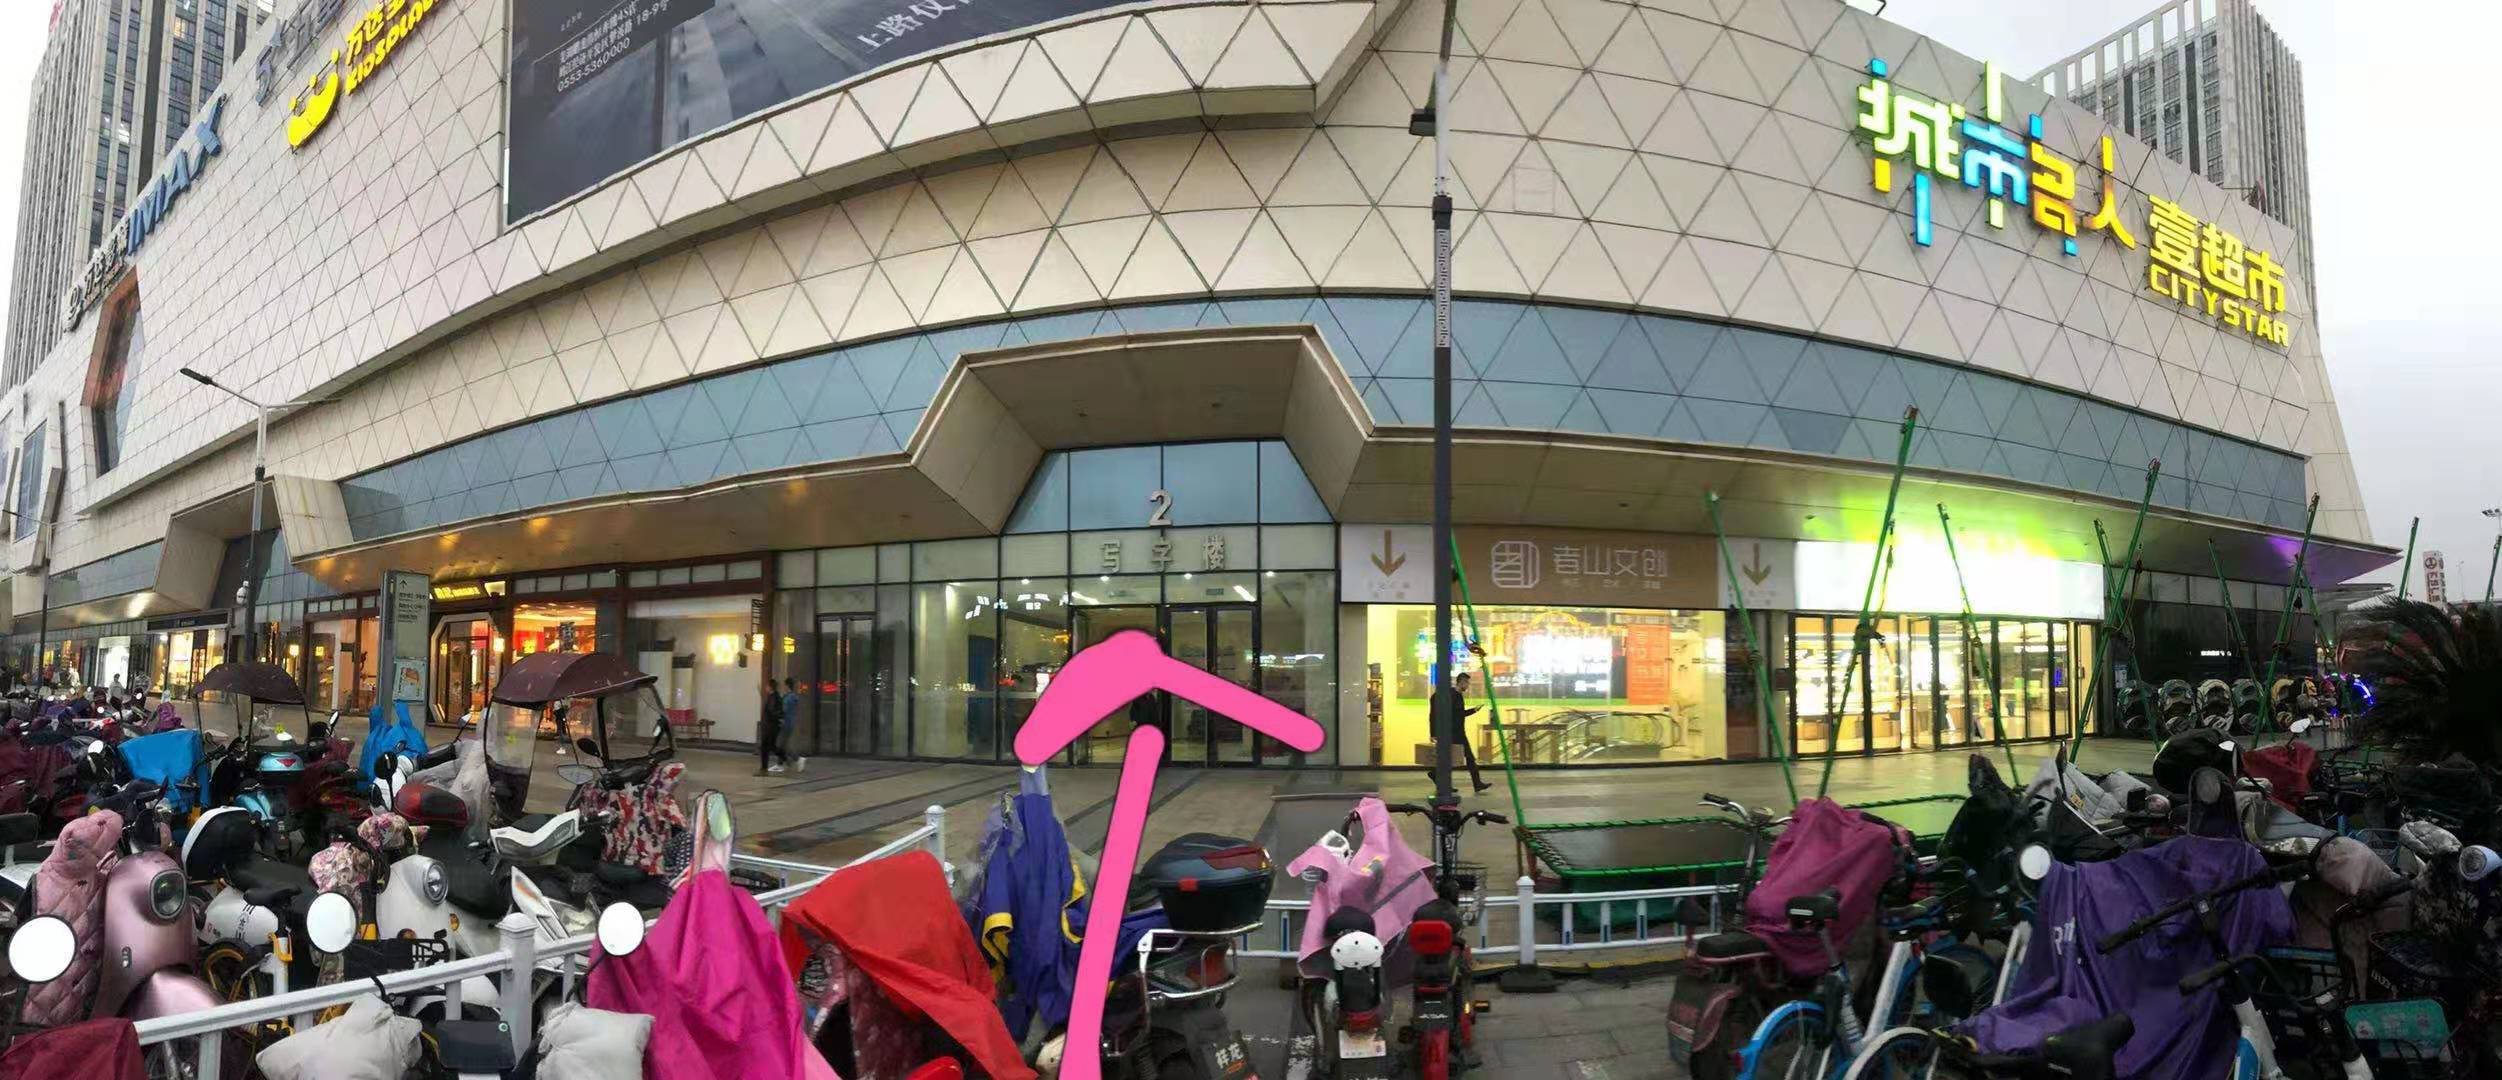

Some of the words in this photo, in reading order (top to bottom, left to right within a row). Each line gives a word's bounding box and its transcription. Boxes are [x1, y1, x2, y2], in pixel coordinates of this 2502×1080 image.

[857, 0, 970, 48] 上路仅
[557, 37, 631, 92] 0553-5360000
[128, 93, 226, 256] IMAX
[1857, 57, 2136, 255] 城市名人
[2148, 194, 2286, 312] 壹超市
[2149, 264, 2218, 316] CITY
[2222, 301, 2290, 348] STAR
[1149, 489, 1173, 526] 2
[1100, 533, 1226, 573] 写字楼
